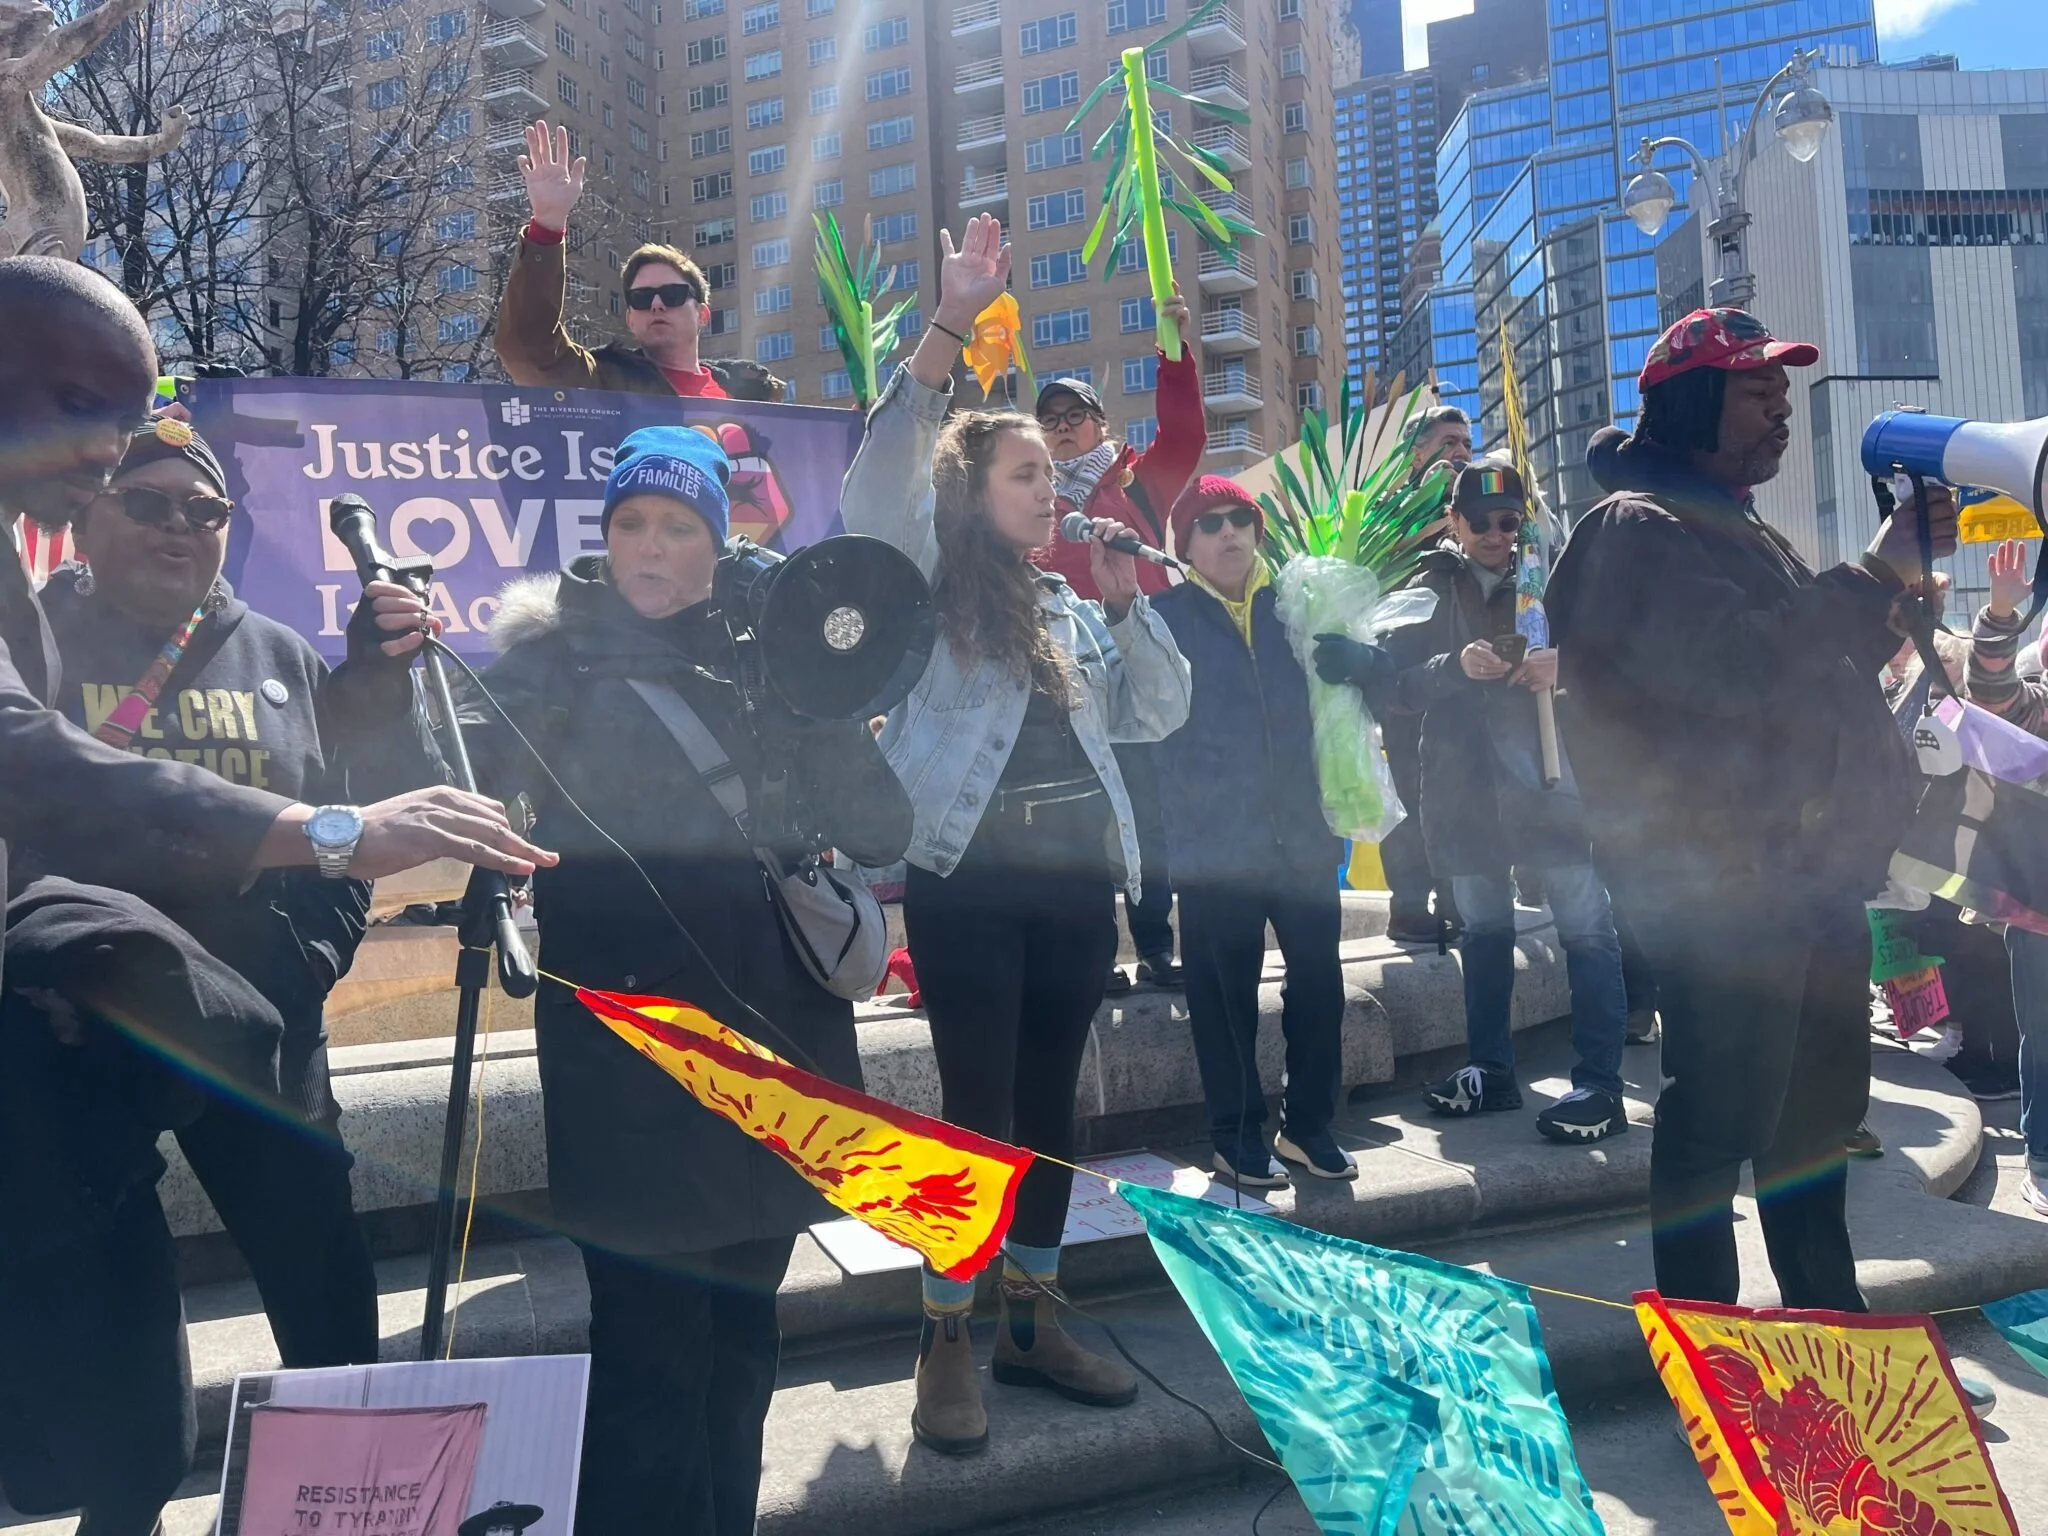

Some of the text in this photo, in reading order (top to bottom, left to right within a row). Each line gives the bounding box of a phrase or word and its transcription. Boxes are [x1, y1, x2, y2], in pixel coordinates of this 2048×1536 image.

[550, 406, 588, 414] RIVERSIDE
[591, 408, 621, 416] CHURCH
[302, 424, 617, 481] Justice Is
[637, 468, 700, 500] FAMILIES
[670, 458, 702, 486] FREE
[318, 496, 610, 572] LOVE
[178, 688, 259, 741] CRY
[1899, 987, 1945, 1031] TRUMP
[296, 1482, 422, 1504] RESISTANCE
[295, 1509, 322, 1528] TO
